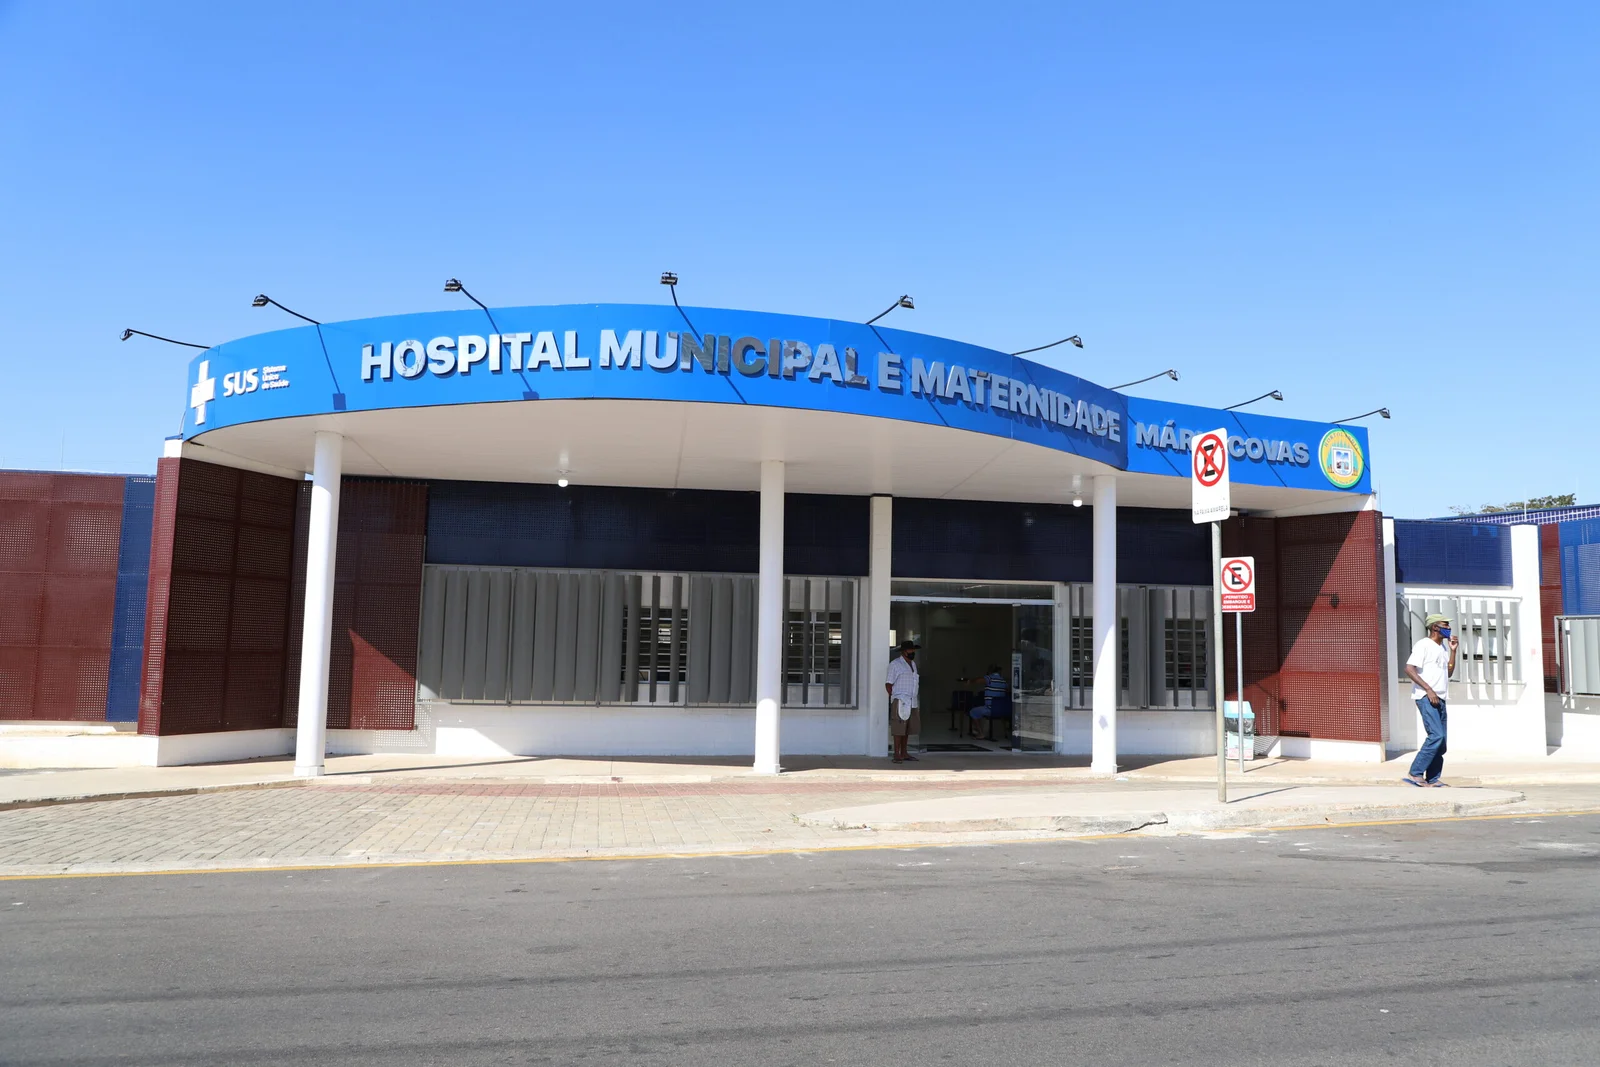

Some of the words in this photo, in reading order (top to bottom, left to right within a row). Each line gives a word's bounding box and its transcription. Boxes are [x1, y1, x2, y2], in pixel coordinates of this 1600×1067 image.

[223, 368, 259, 397] SUS
[361, 330, 590, 383] HOSPITAL
[599, 328, 868, 386] MUNICIPAL
[877, 352, 901, 390] E
[911, 357, 1121, 443] MATERNIDADE
[1136, 419, 1203, 452] MÁR
[1227, 435, 1310, 465] COVAS
